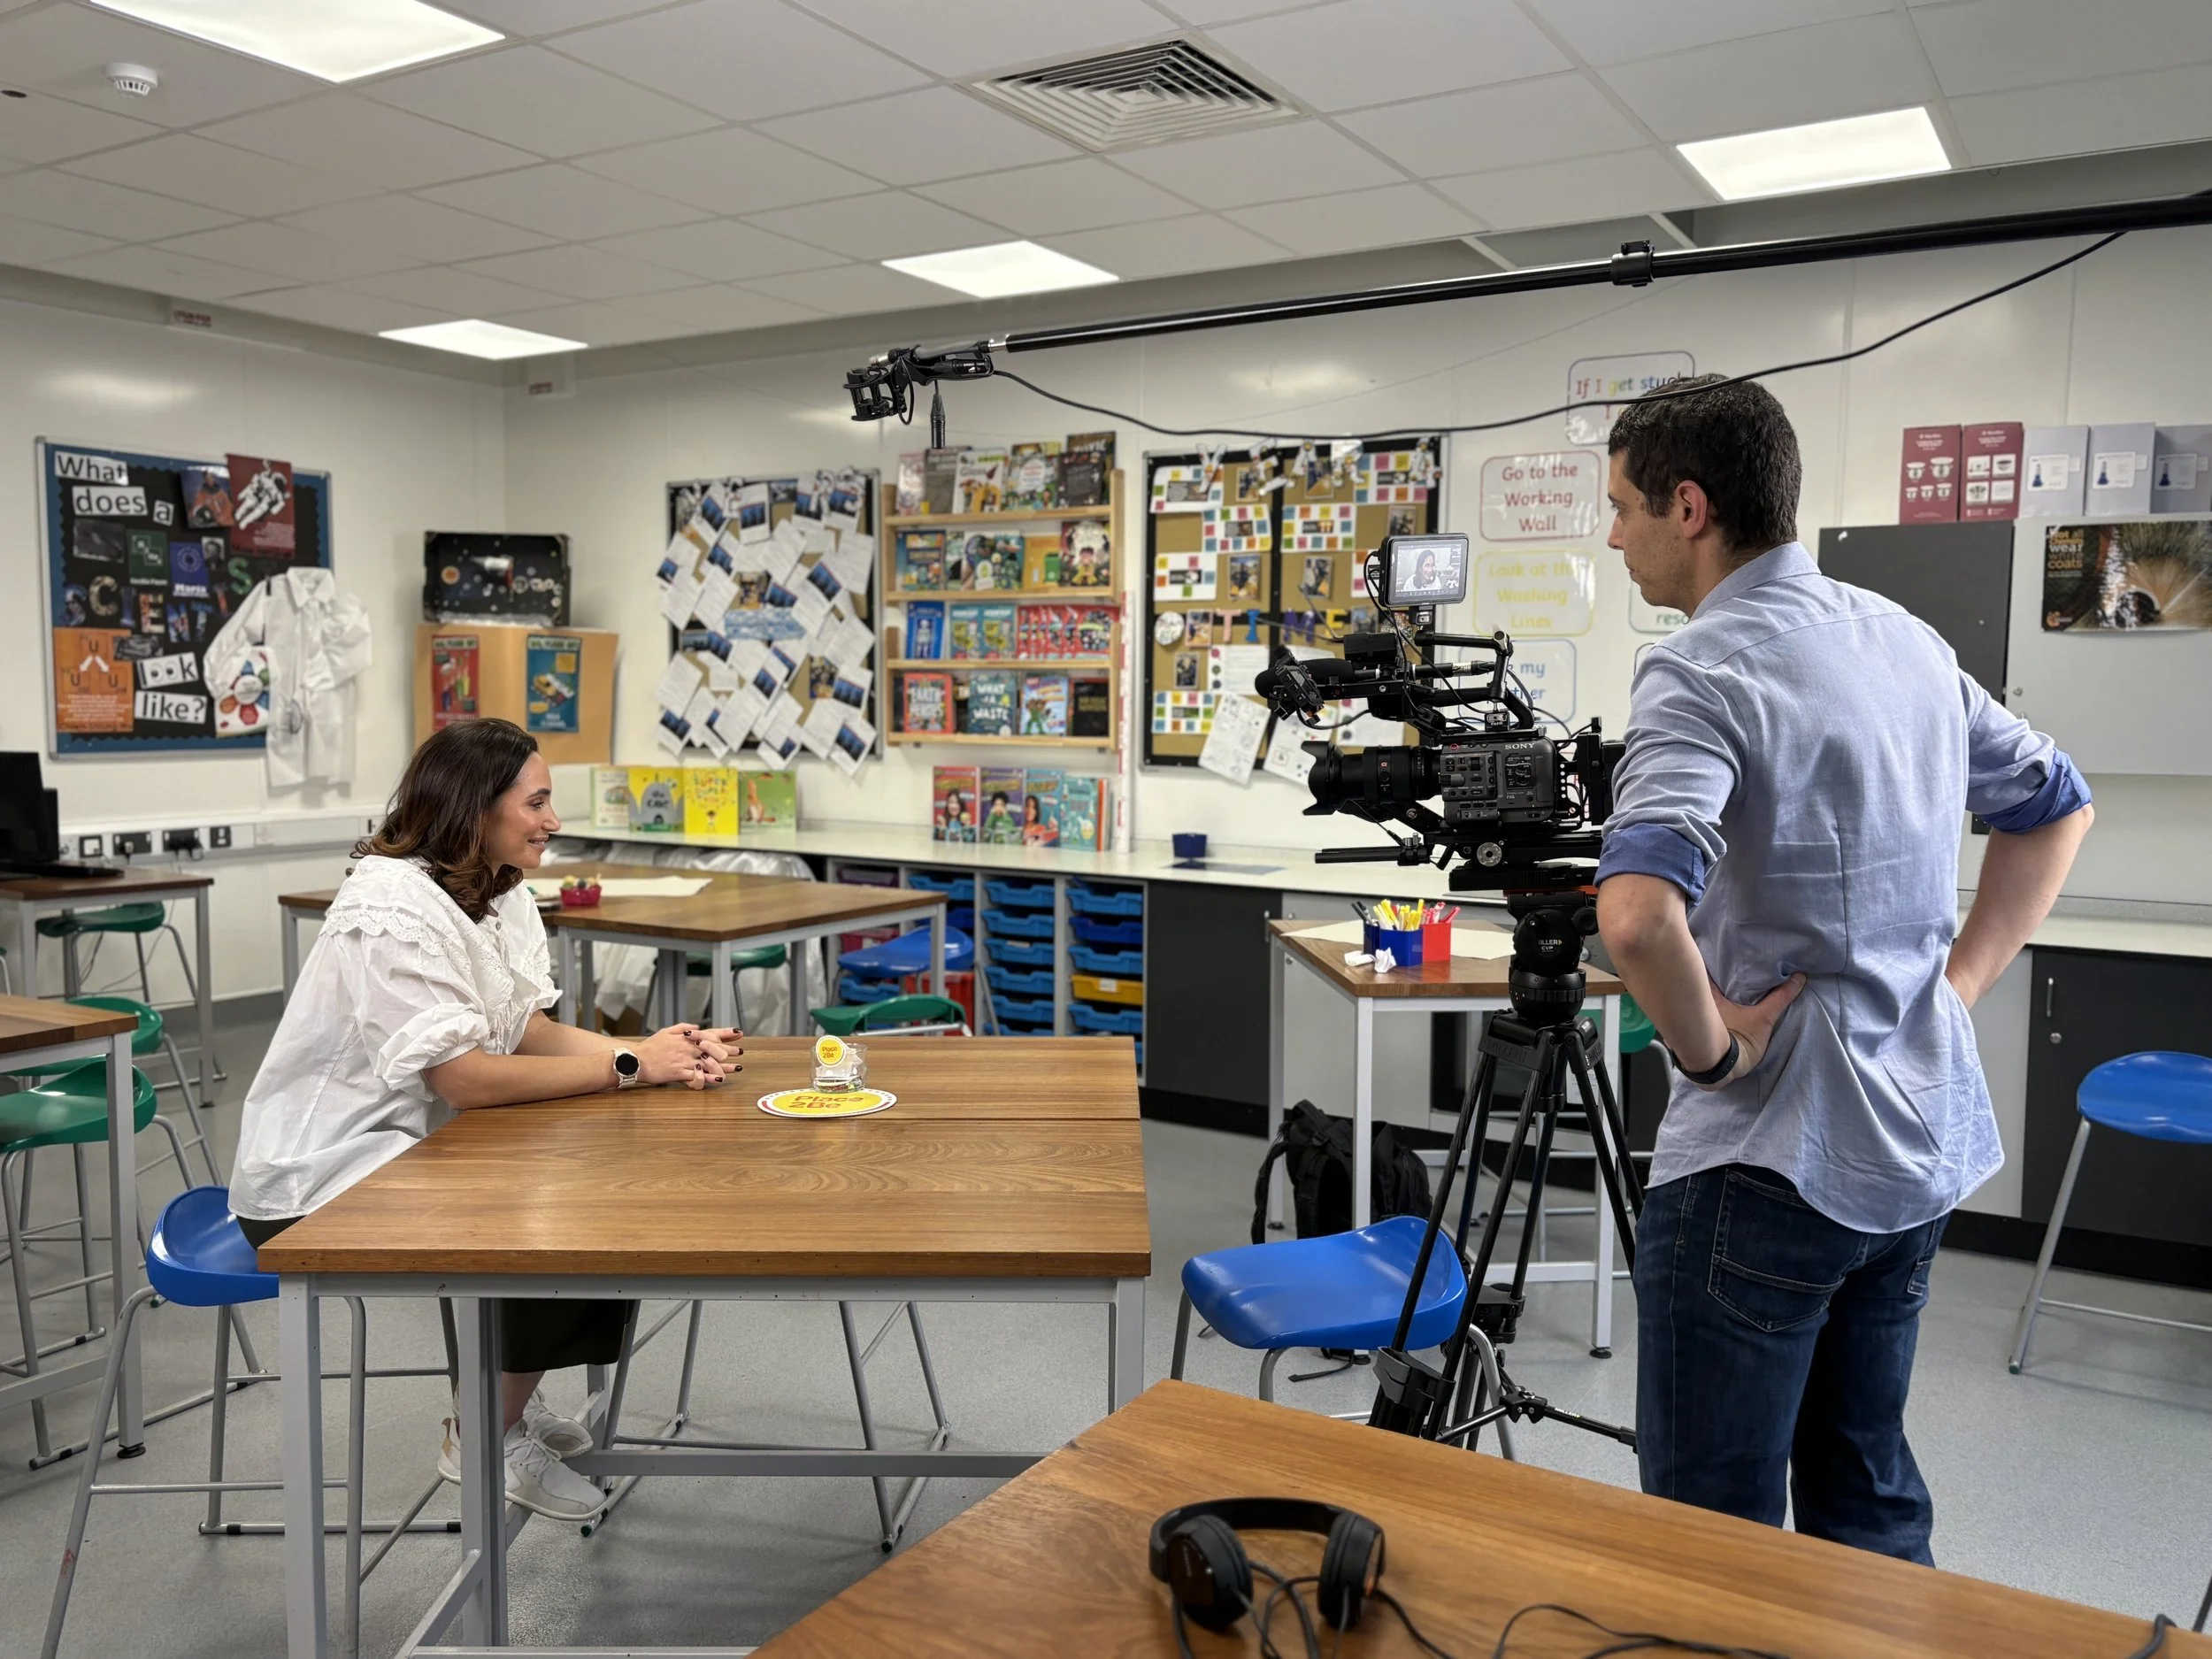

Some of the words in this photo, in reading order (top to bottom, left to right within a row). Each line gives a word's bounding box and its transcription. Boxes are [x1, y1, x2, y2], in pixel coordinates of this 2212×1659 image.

[1577, 379, 1590, 398] If
[1595, 379, 1602, 393] I
[1609, 378, 1633, 396] get
[58, 455, 125, 481] What
[1502, 466, 1524, 481] Go
[1530, 466, 1546, 479] to
[1552, 462, 1578, 478] the
[76, 488, 144, 513] does
[157, 504, 171, 522] a
[1504, 489, 1573, 508] Working
[1518, 515, 1556, 532] Wall
[1488, 562, 1525, 577] Look
[1530, 564, 1548, 576] at
[1497, 588, 1568, 606] Washing
[1510, 615, 1552, 628] Lines
[1520, 663, 1546, 678] my
[142, 693, 206, 721] like?
